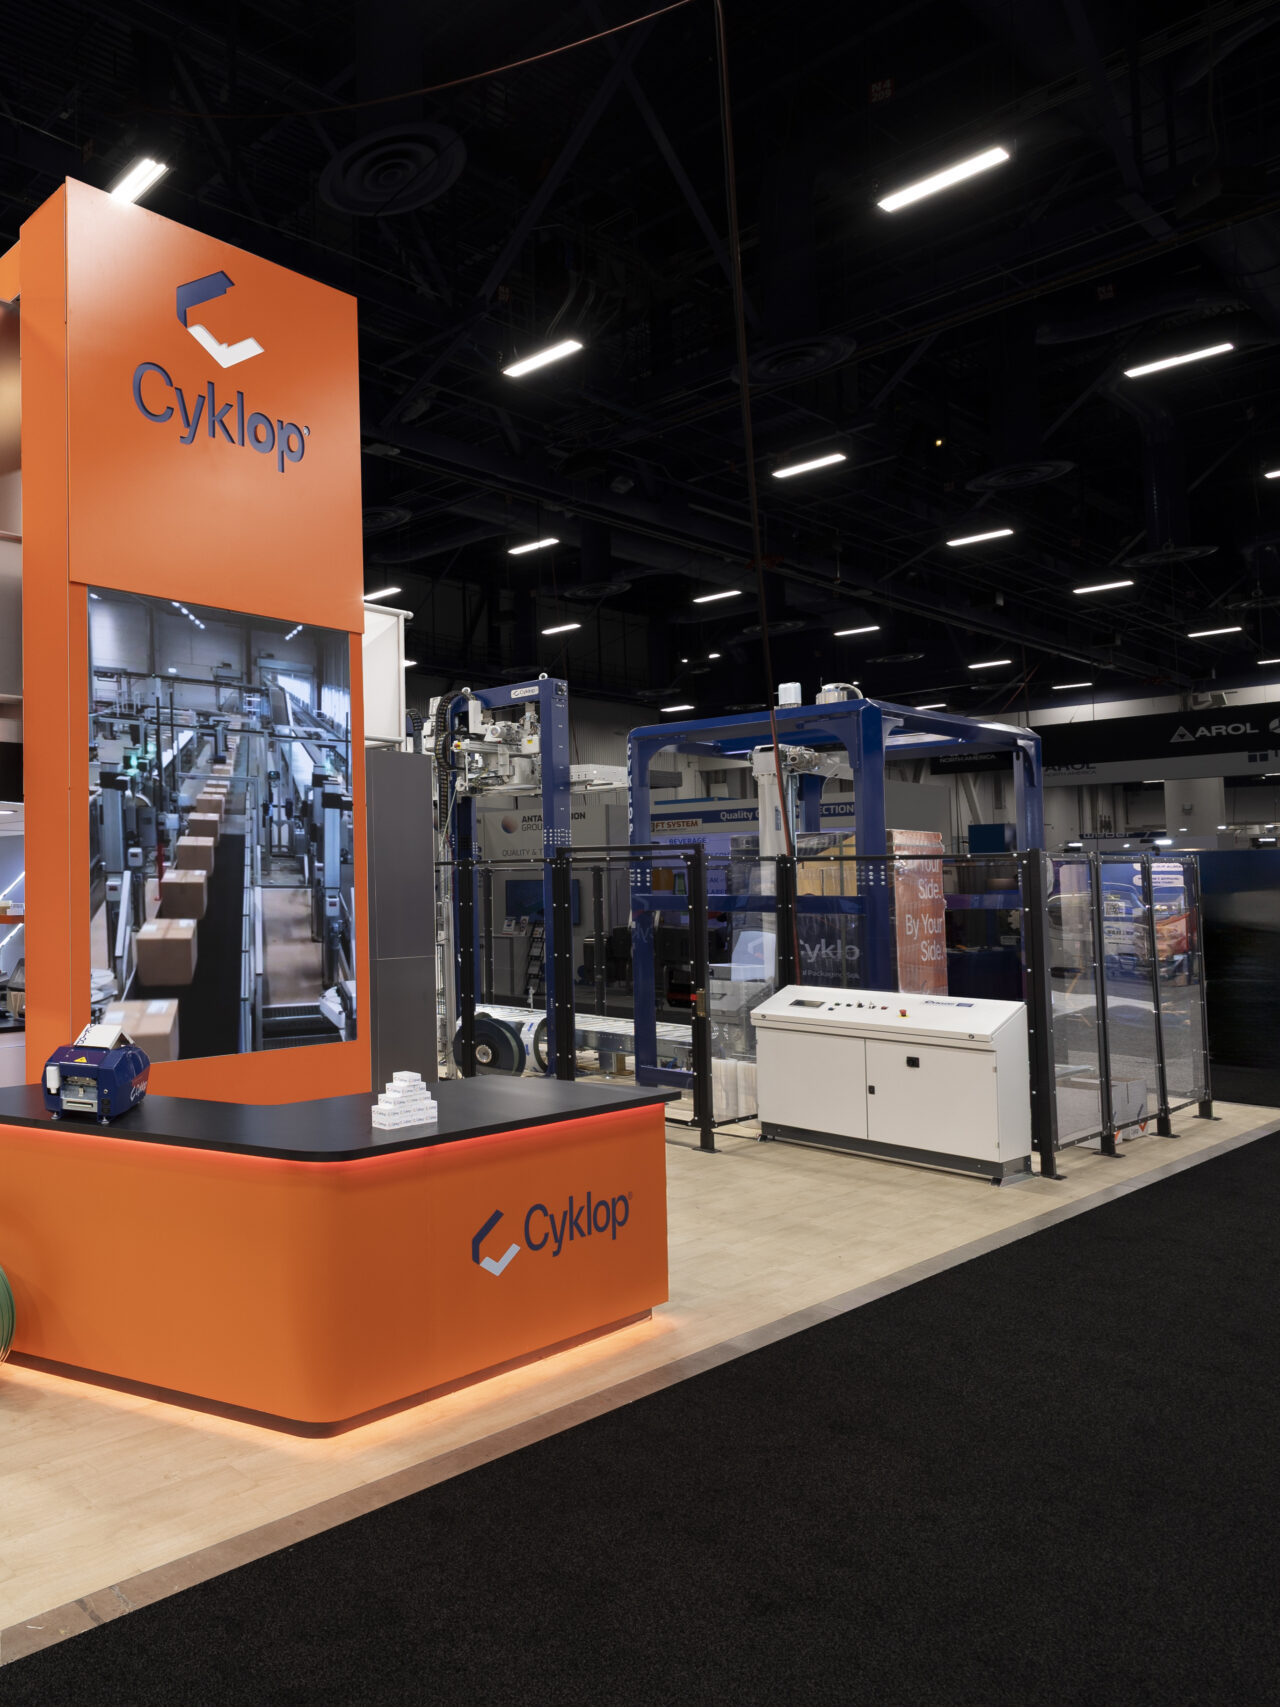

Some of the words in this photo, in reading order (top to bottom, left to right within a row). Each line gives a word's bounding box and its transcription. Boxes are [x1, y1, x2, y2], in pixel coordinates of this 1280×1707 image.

[132, 361, 305, 474] Cyklop
[1195, 722, 1260, 738] AROL
[666, 820, 699, 829] SYSTEM
[720, 811, 753, 821] Quality
[522, 823, 543, 831] GROU
[502, 849, 530, 857] QUALITY
[905, 914, 920, 939] By
[921, 913, 943, 934] Your
[800, 938, 860, 963] yklo
[920, 940, 944, 961] Side.
[523, 1191, 629, 1257] Cyklop
